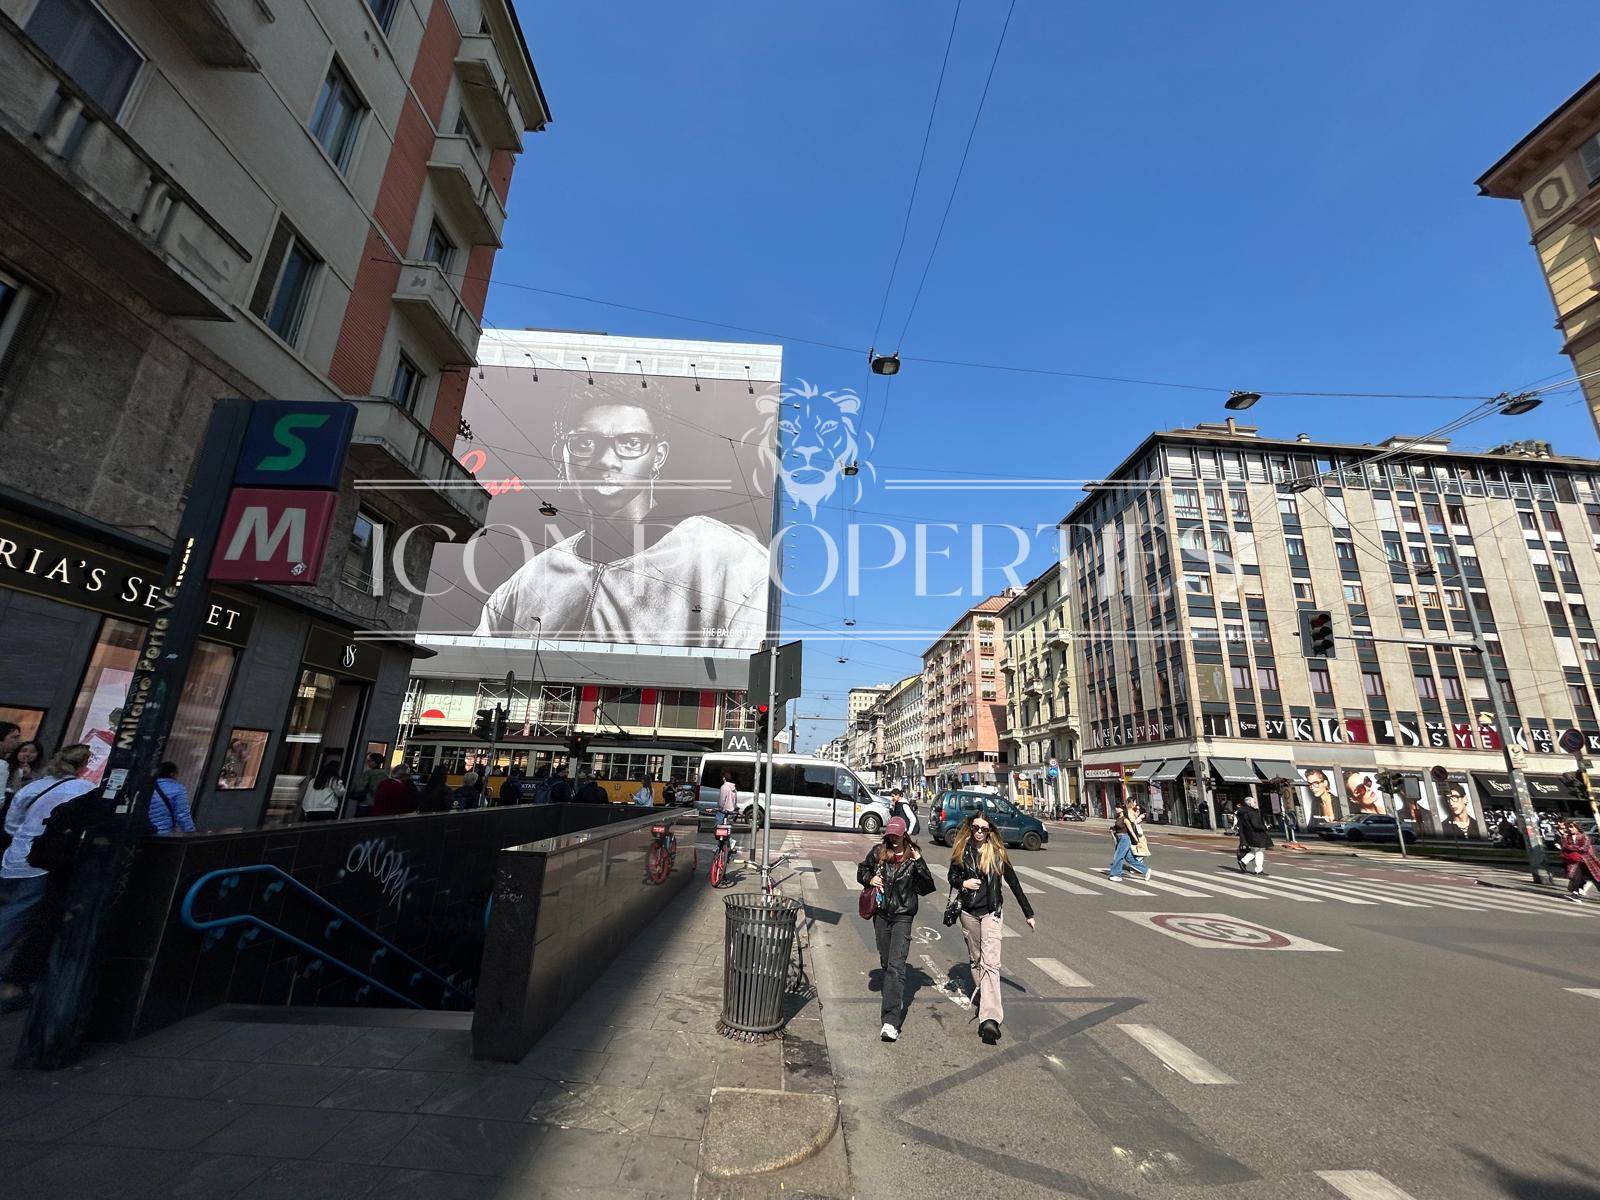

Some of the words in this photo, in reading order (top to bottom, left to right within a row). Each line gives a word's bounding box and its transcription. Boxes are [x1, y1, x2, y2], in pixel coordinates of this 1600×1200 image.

[256, 413, 331, 471] S
[223, 506, 307, 562] M
[121, 575, 240, 630] SEET
[702, 627, 716, 637] THE
[117, 677, 152, 749] Milano
[137, 618, 170, 672] Porta
